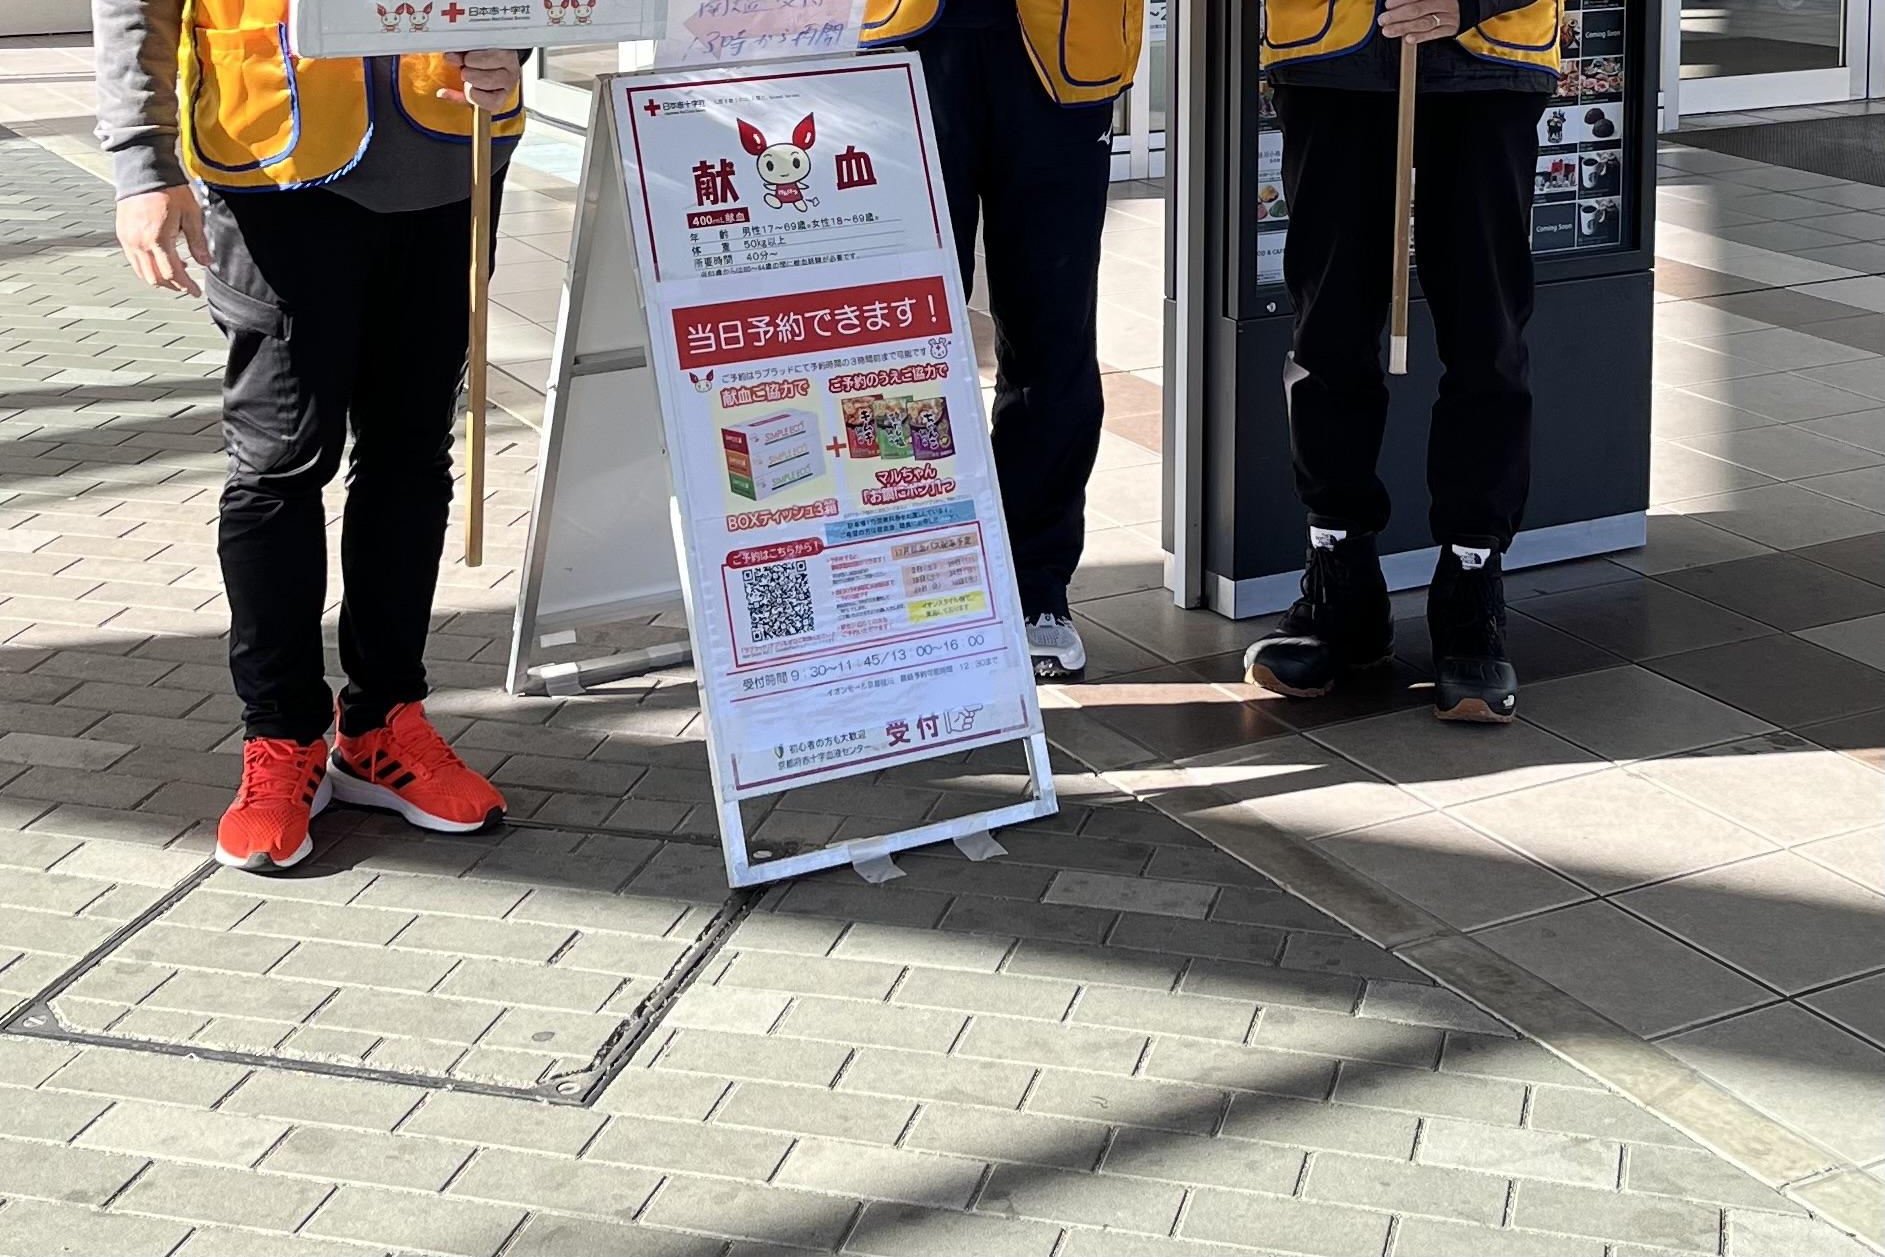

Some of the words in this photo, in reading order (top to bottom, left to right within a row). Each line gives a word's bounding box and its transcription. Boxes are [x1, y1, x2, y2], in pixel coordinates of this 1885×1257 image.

[1536, 225, 1558, 233] Coming
[720, 378, 810, 409] 献血ご協力で
[828, 362, 948, 394] ご予約のうえご協力で
[875, 462, 938, 487] マルちゃん
[726, 498, 839, 533] BOXティッシュ3箱
[742, 671, 788, 692] 受付時間
[885, 714, 940, 747] 受付
